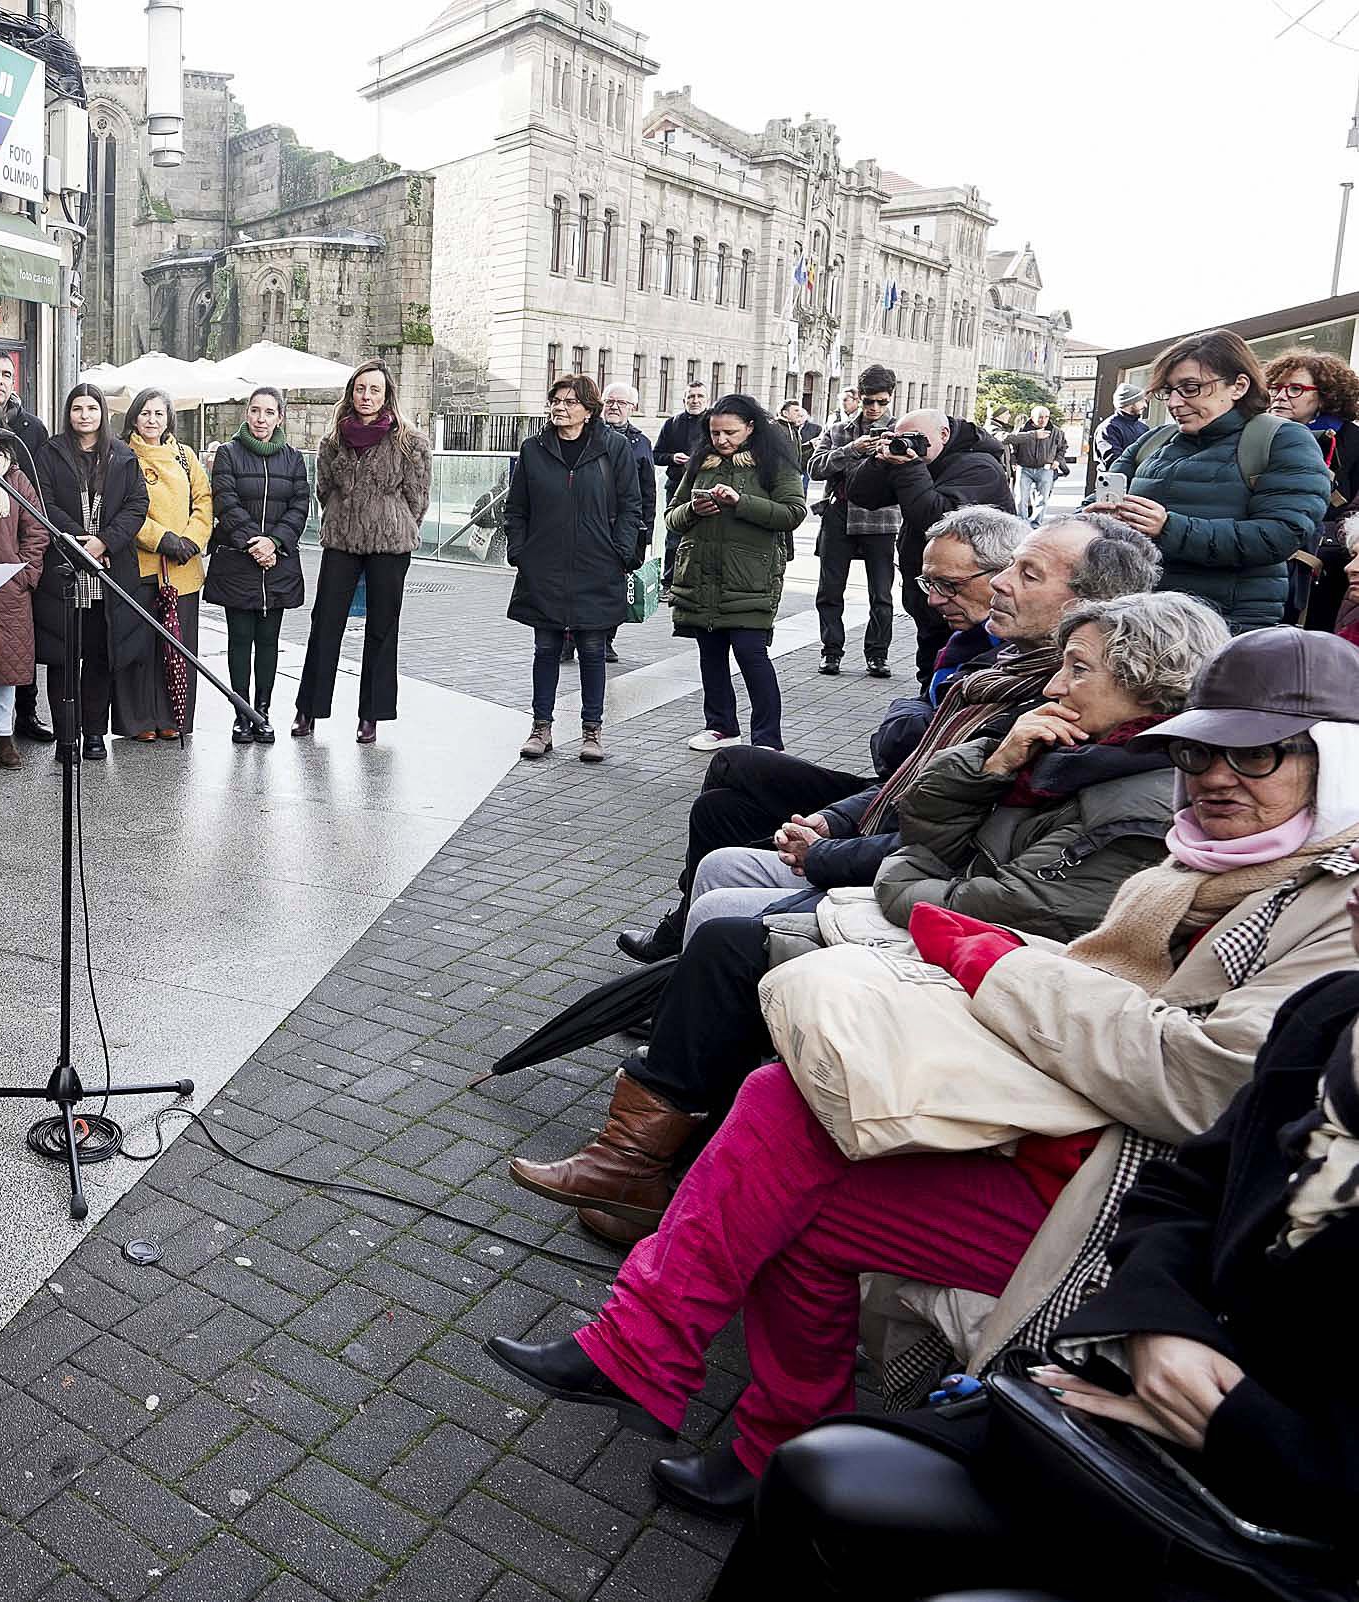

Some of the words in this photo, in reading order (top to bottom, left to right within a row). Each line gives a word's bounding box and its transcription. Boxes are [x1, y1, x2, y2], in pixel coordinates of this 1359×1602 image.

[9, 144, 32, 166] FOTO
[2, 164, 39, 190] OLIMPIO
[626, 572, 635, 606] GEOX
